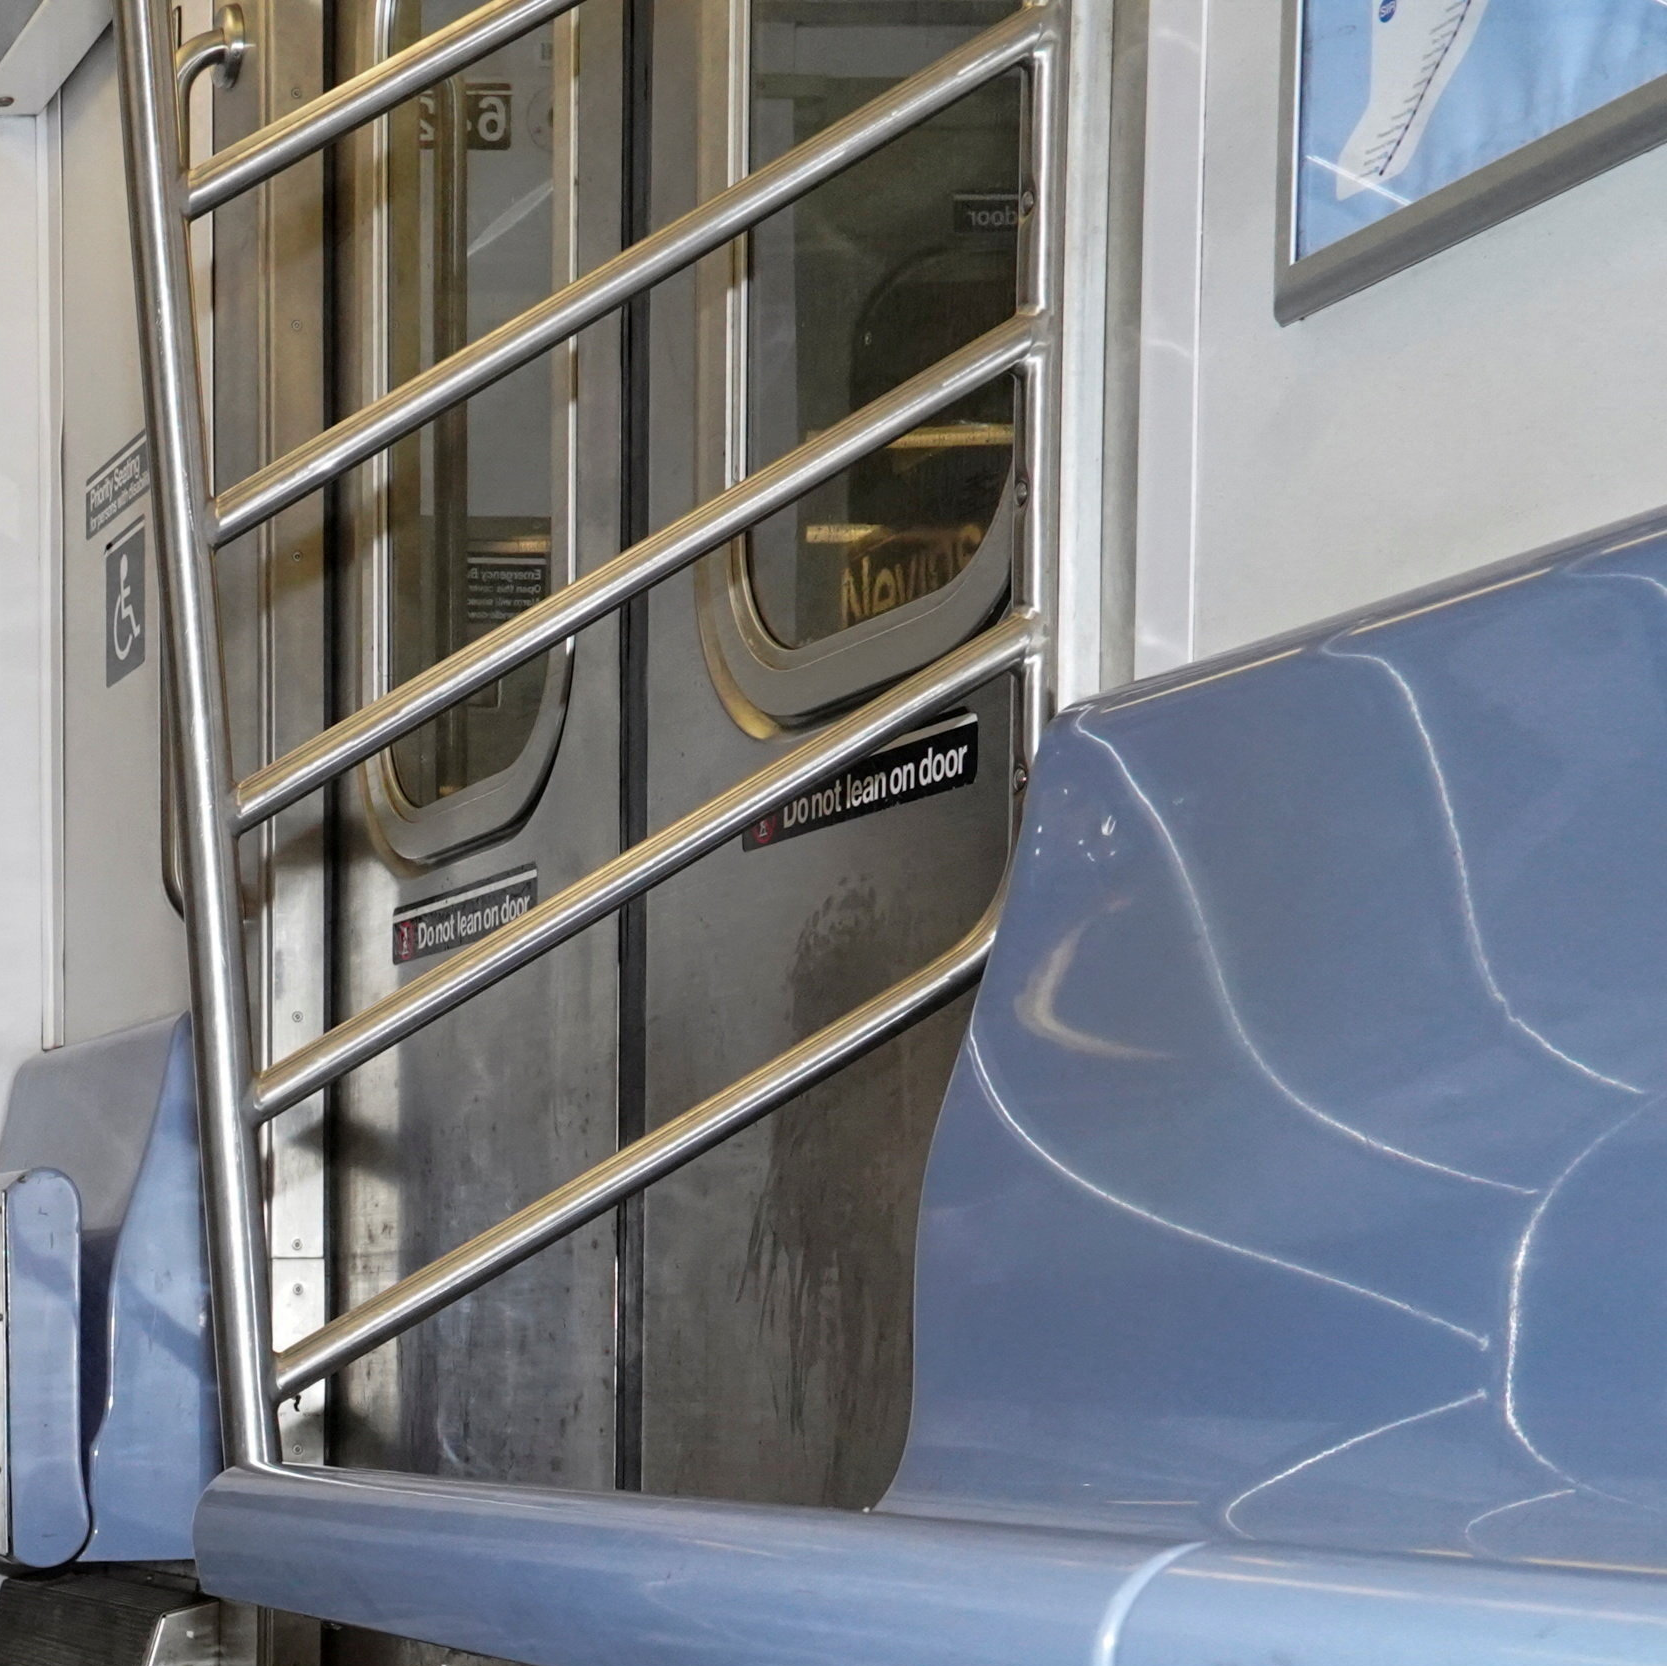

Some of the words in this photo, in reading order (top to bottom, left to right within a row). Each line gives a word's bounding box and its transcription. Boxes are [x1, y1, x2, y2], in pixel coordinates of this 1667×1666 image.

[783, 797, 809, 828] Do
[811, 779, 842, 818] not
[846, 771, 887, 809] lean
[889, 761, 915, 795] on
[919, 745, 968, 786] door
[418, 922, 435, 949] Do
[435, 914, 455, 944] not
[457, 911, 482, 937] lean
[483, 905, 499, 929] on
[501, 895, 530, 922] door
